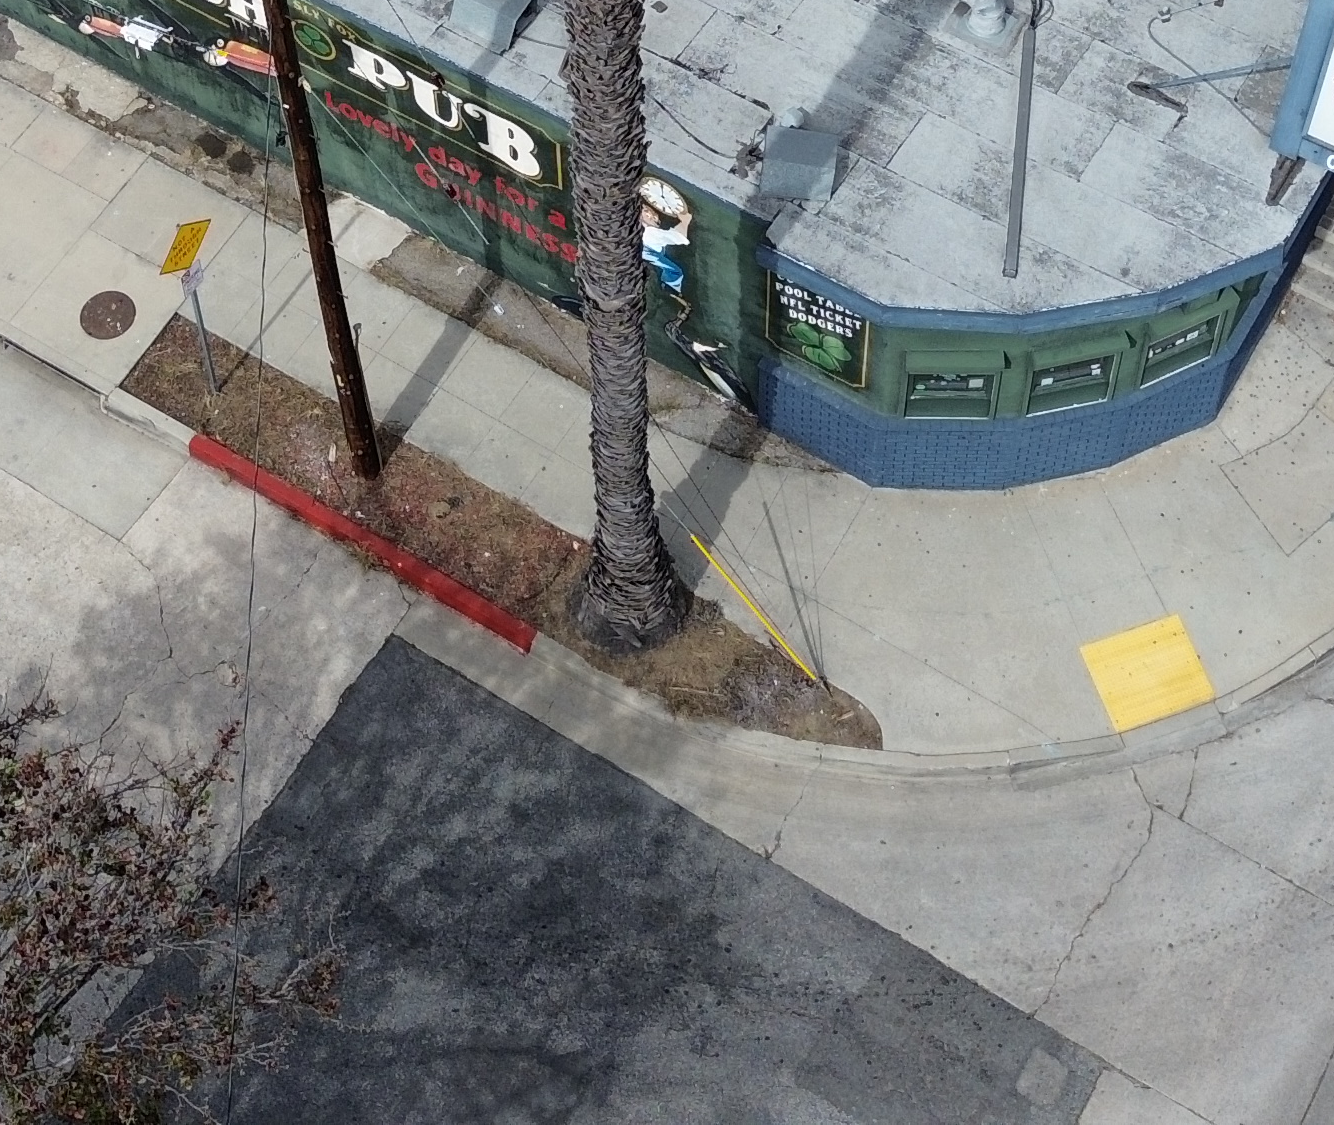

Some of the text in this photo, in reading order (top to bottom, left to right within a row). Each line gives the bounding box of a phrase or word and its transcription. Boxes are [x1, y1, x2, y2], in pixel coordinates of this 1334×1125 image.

[293, 0, 357, 43] SLY FOX
[342, 38, 542, 178] PUB
[324, 91, 567, 230] Lovely day for a
[172, 235, 186, 252] NOT
[775, 281, 863, 319] POOL TAB
[779, 294, 863, 331] NFL TICKET
[788, 308, 853, 339] DODGERS
